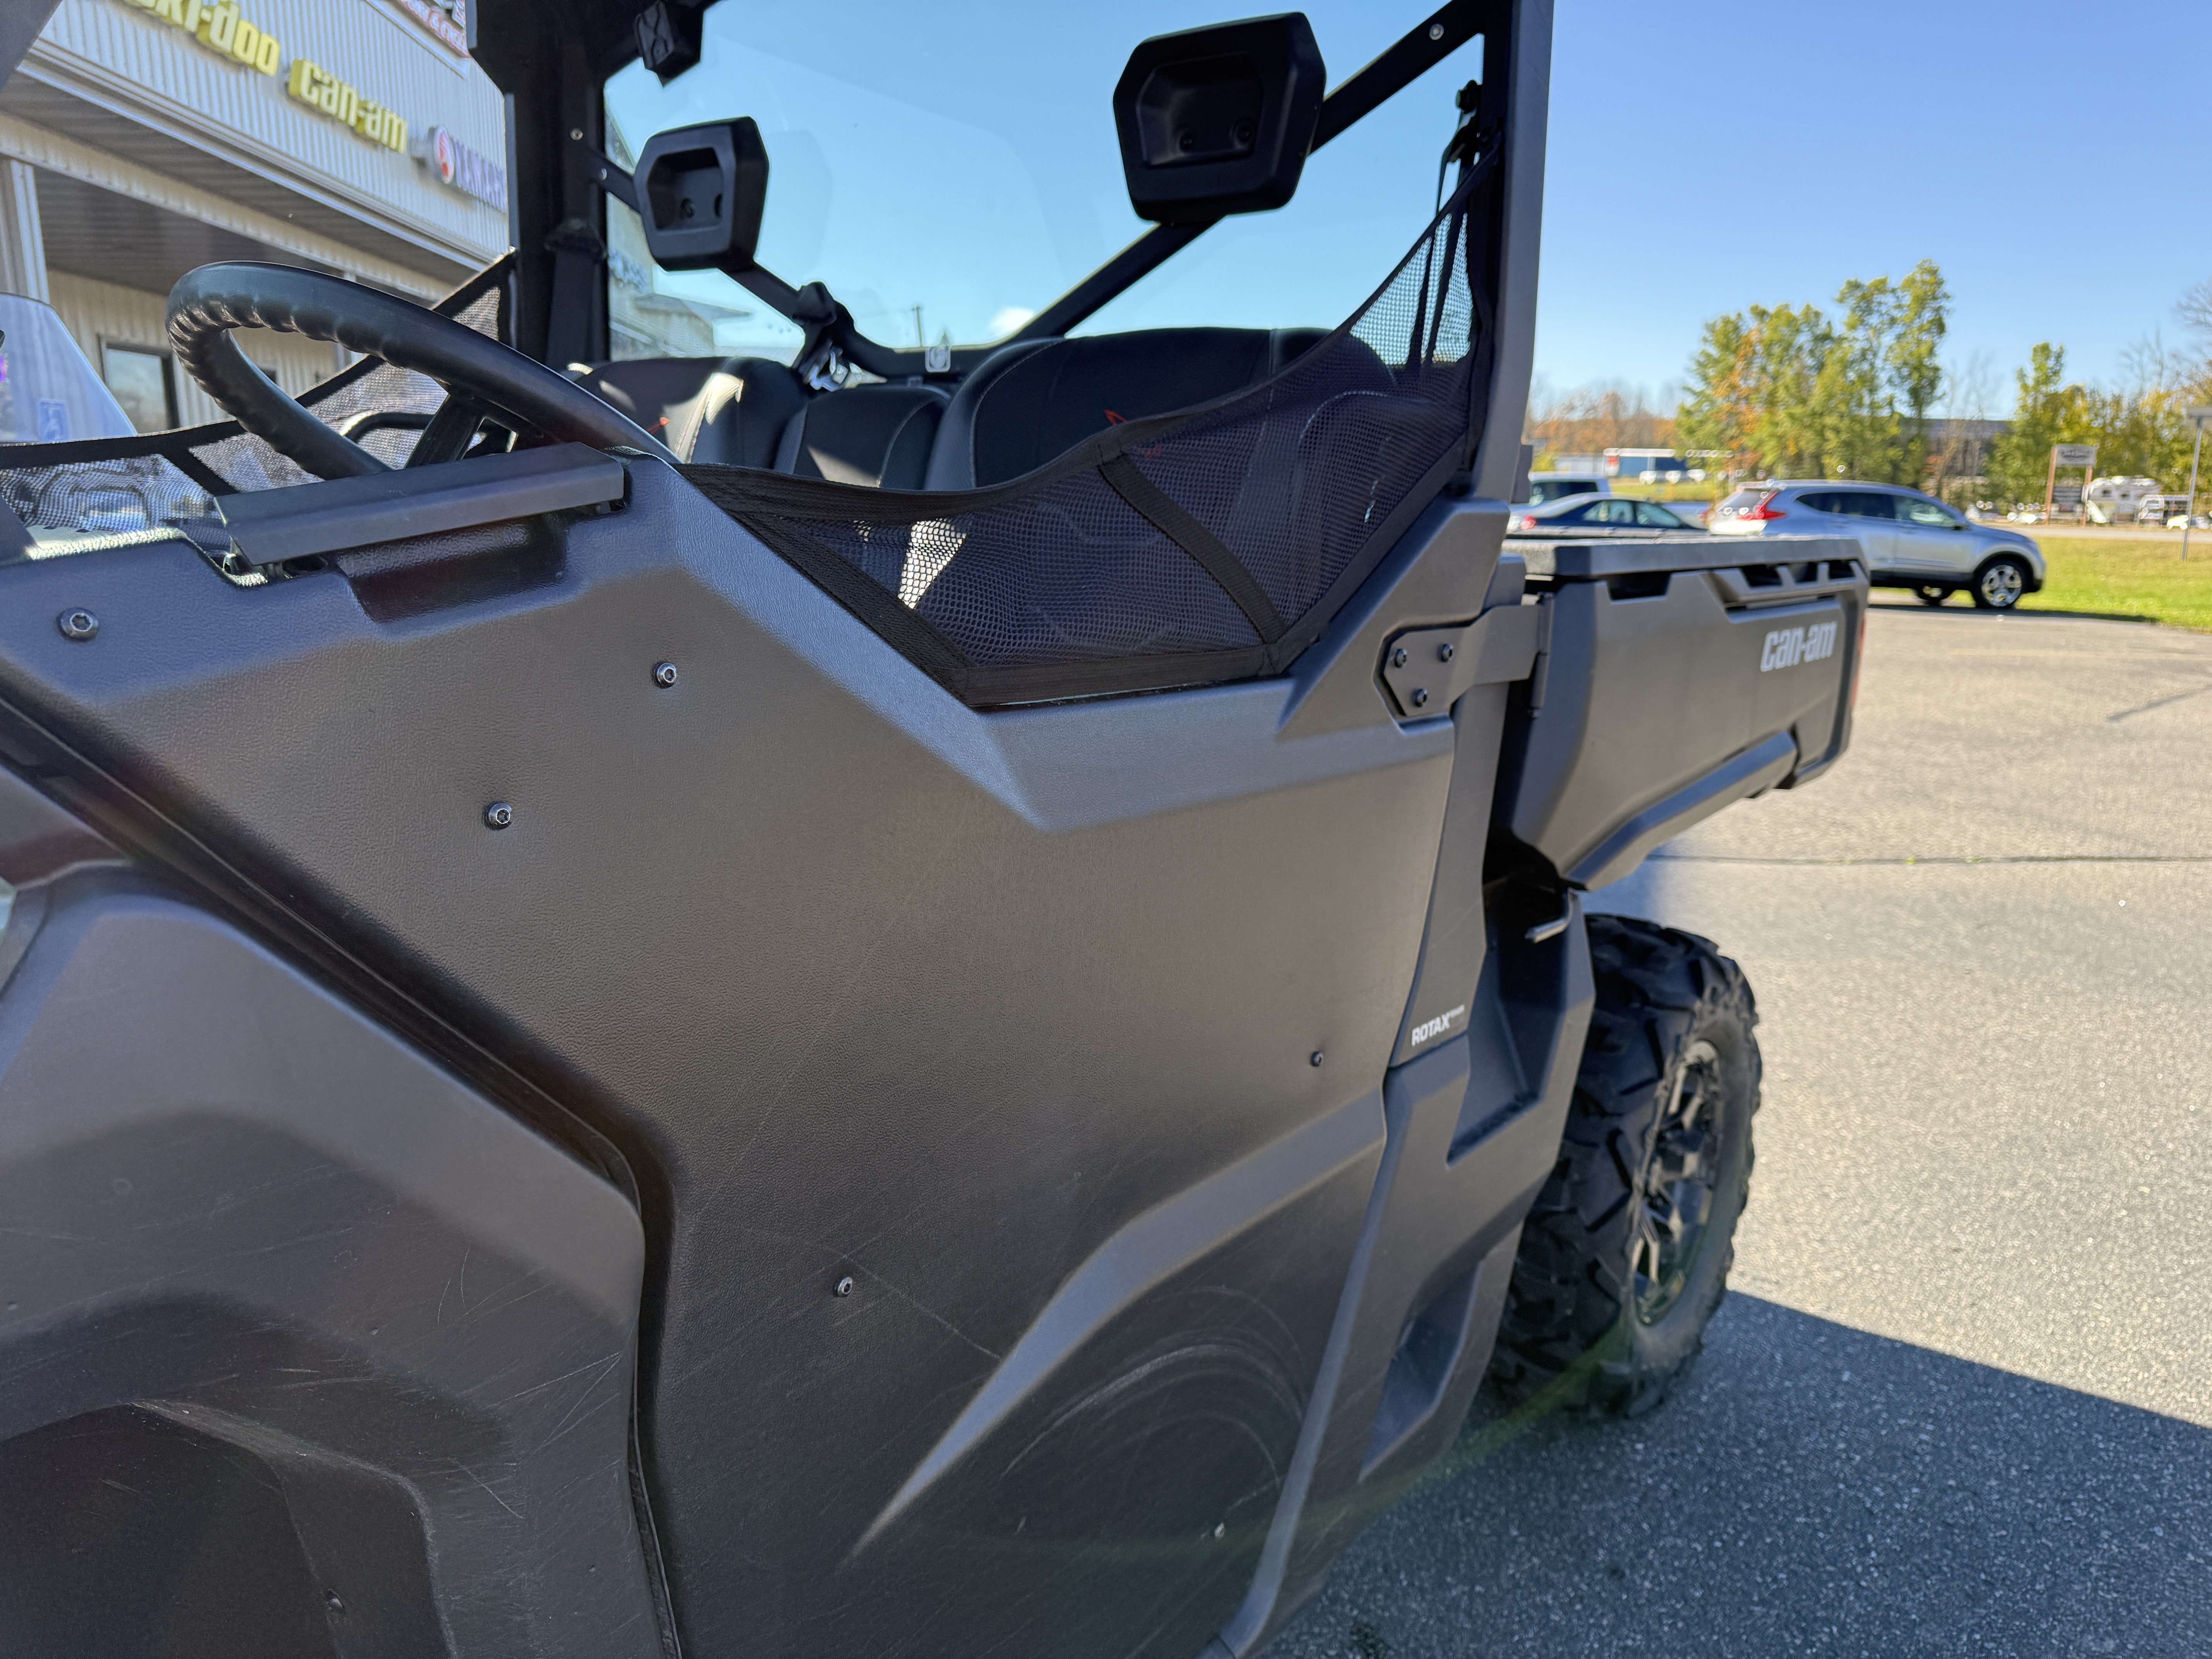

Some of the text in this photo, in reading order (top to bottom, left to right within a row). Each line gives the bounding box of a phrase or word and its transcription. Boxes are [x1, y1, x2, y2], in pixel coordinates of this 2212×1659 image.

[134, 0, 280, 76] i-doo
[1760, 621, 1838, 672] can-am
[1412, 1014, 1450, 1046] ROTAX
